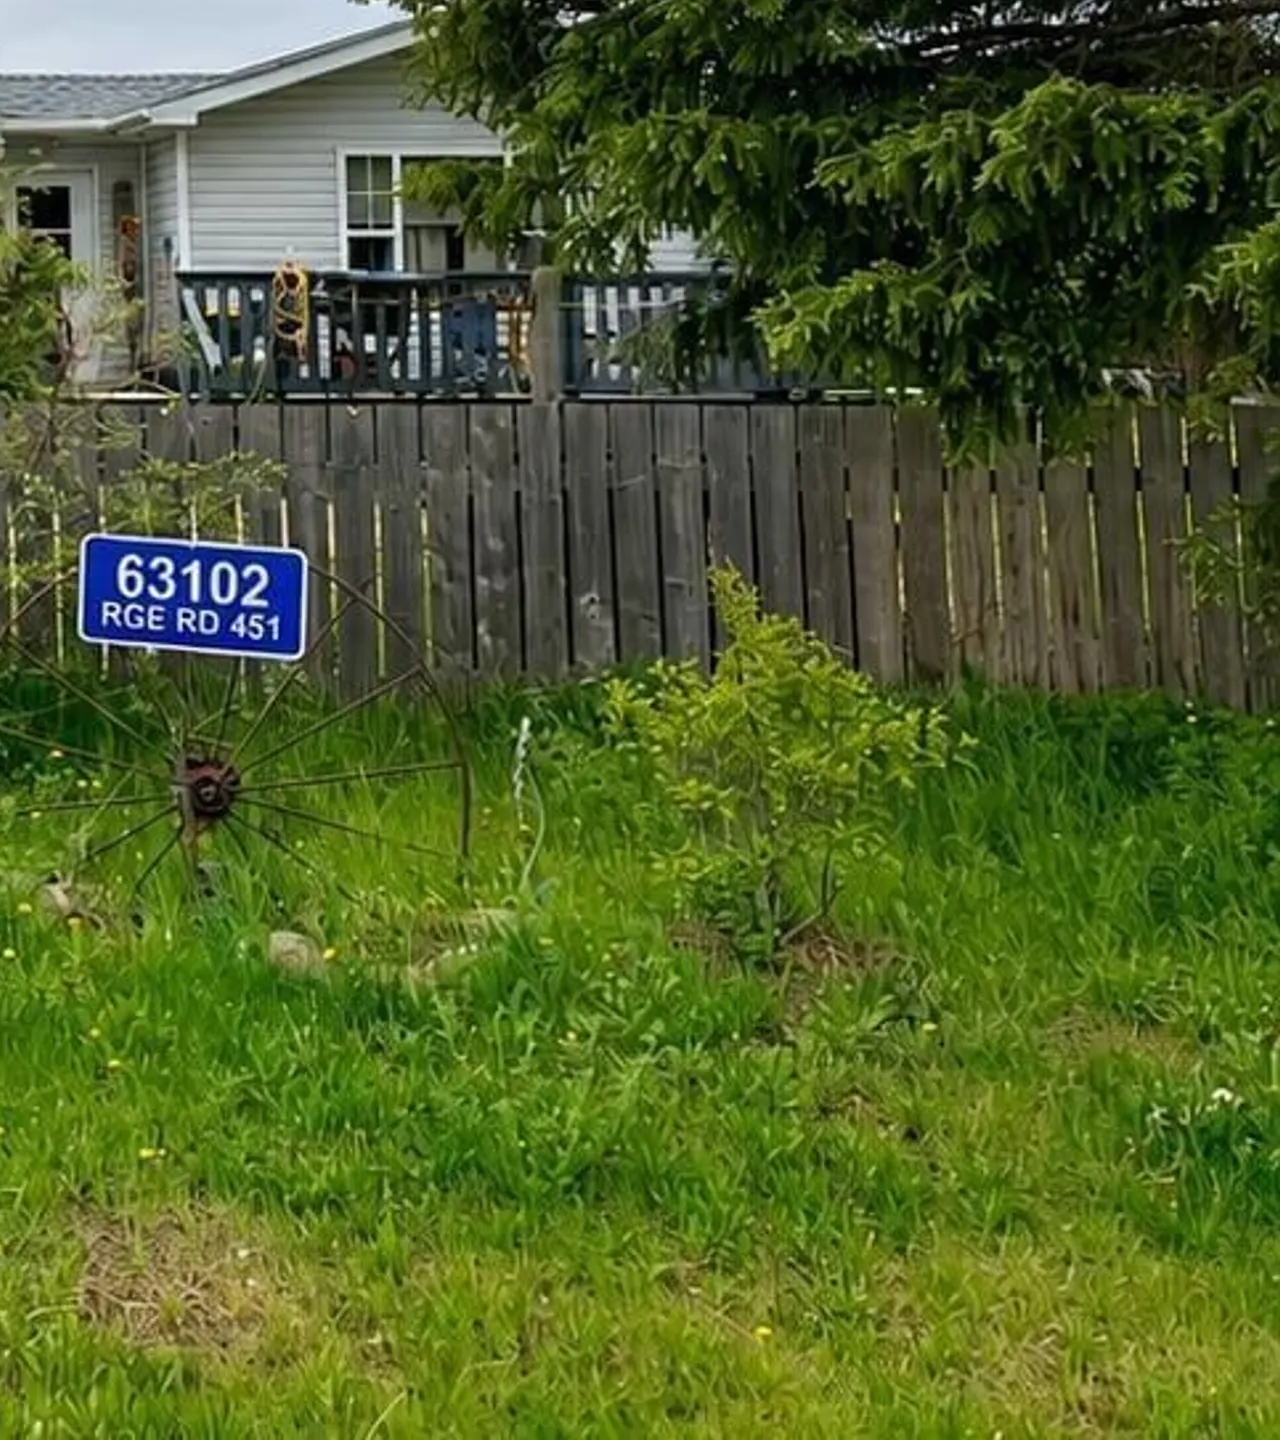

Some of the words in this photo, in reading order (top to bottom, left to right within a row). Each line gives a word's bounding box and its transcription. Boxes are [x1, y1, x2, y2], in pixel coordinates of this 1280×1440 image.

[118, 555, 268, 607] 63102
[101, 601, 165, 630] RGE
[176, 609, 219, 635] RD
[230, 613, 280, 641] 451
